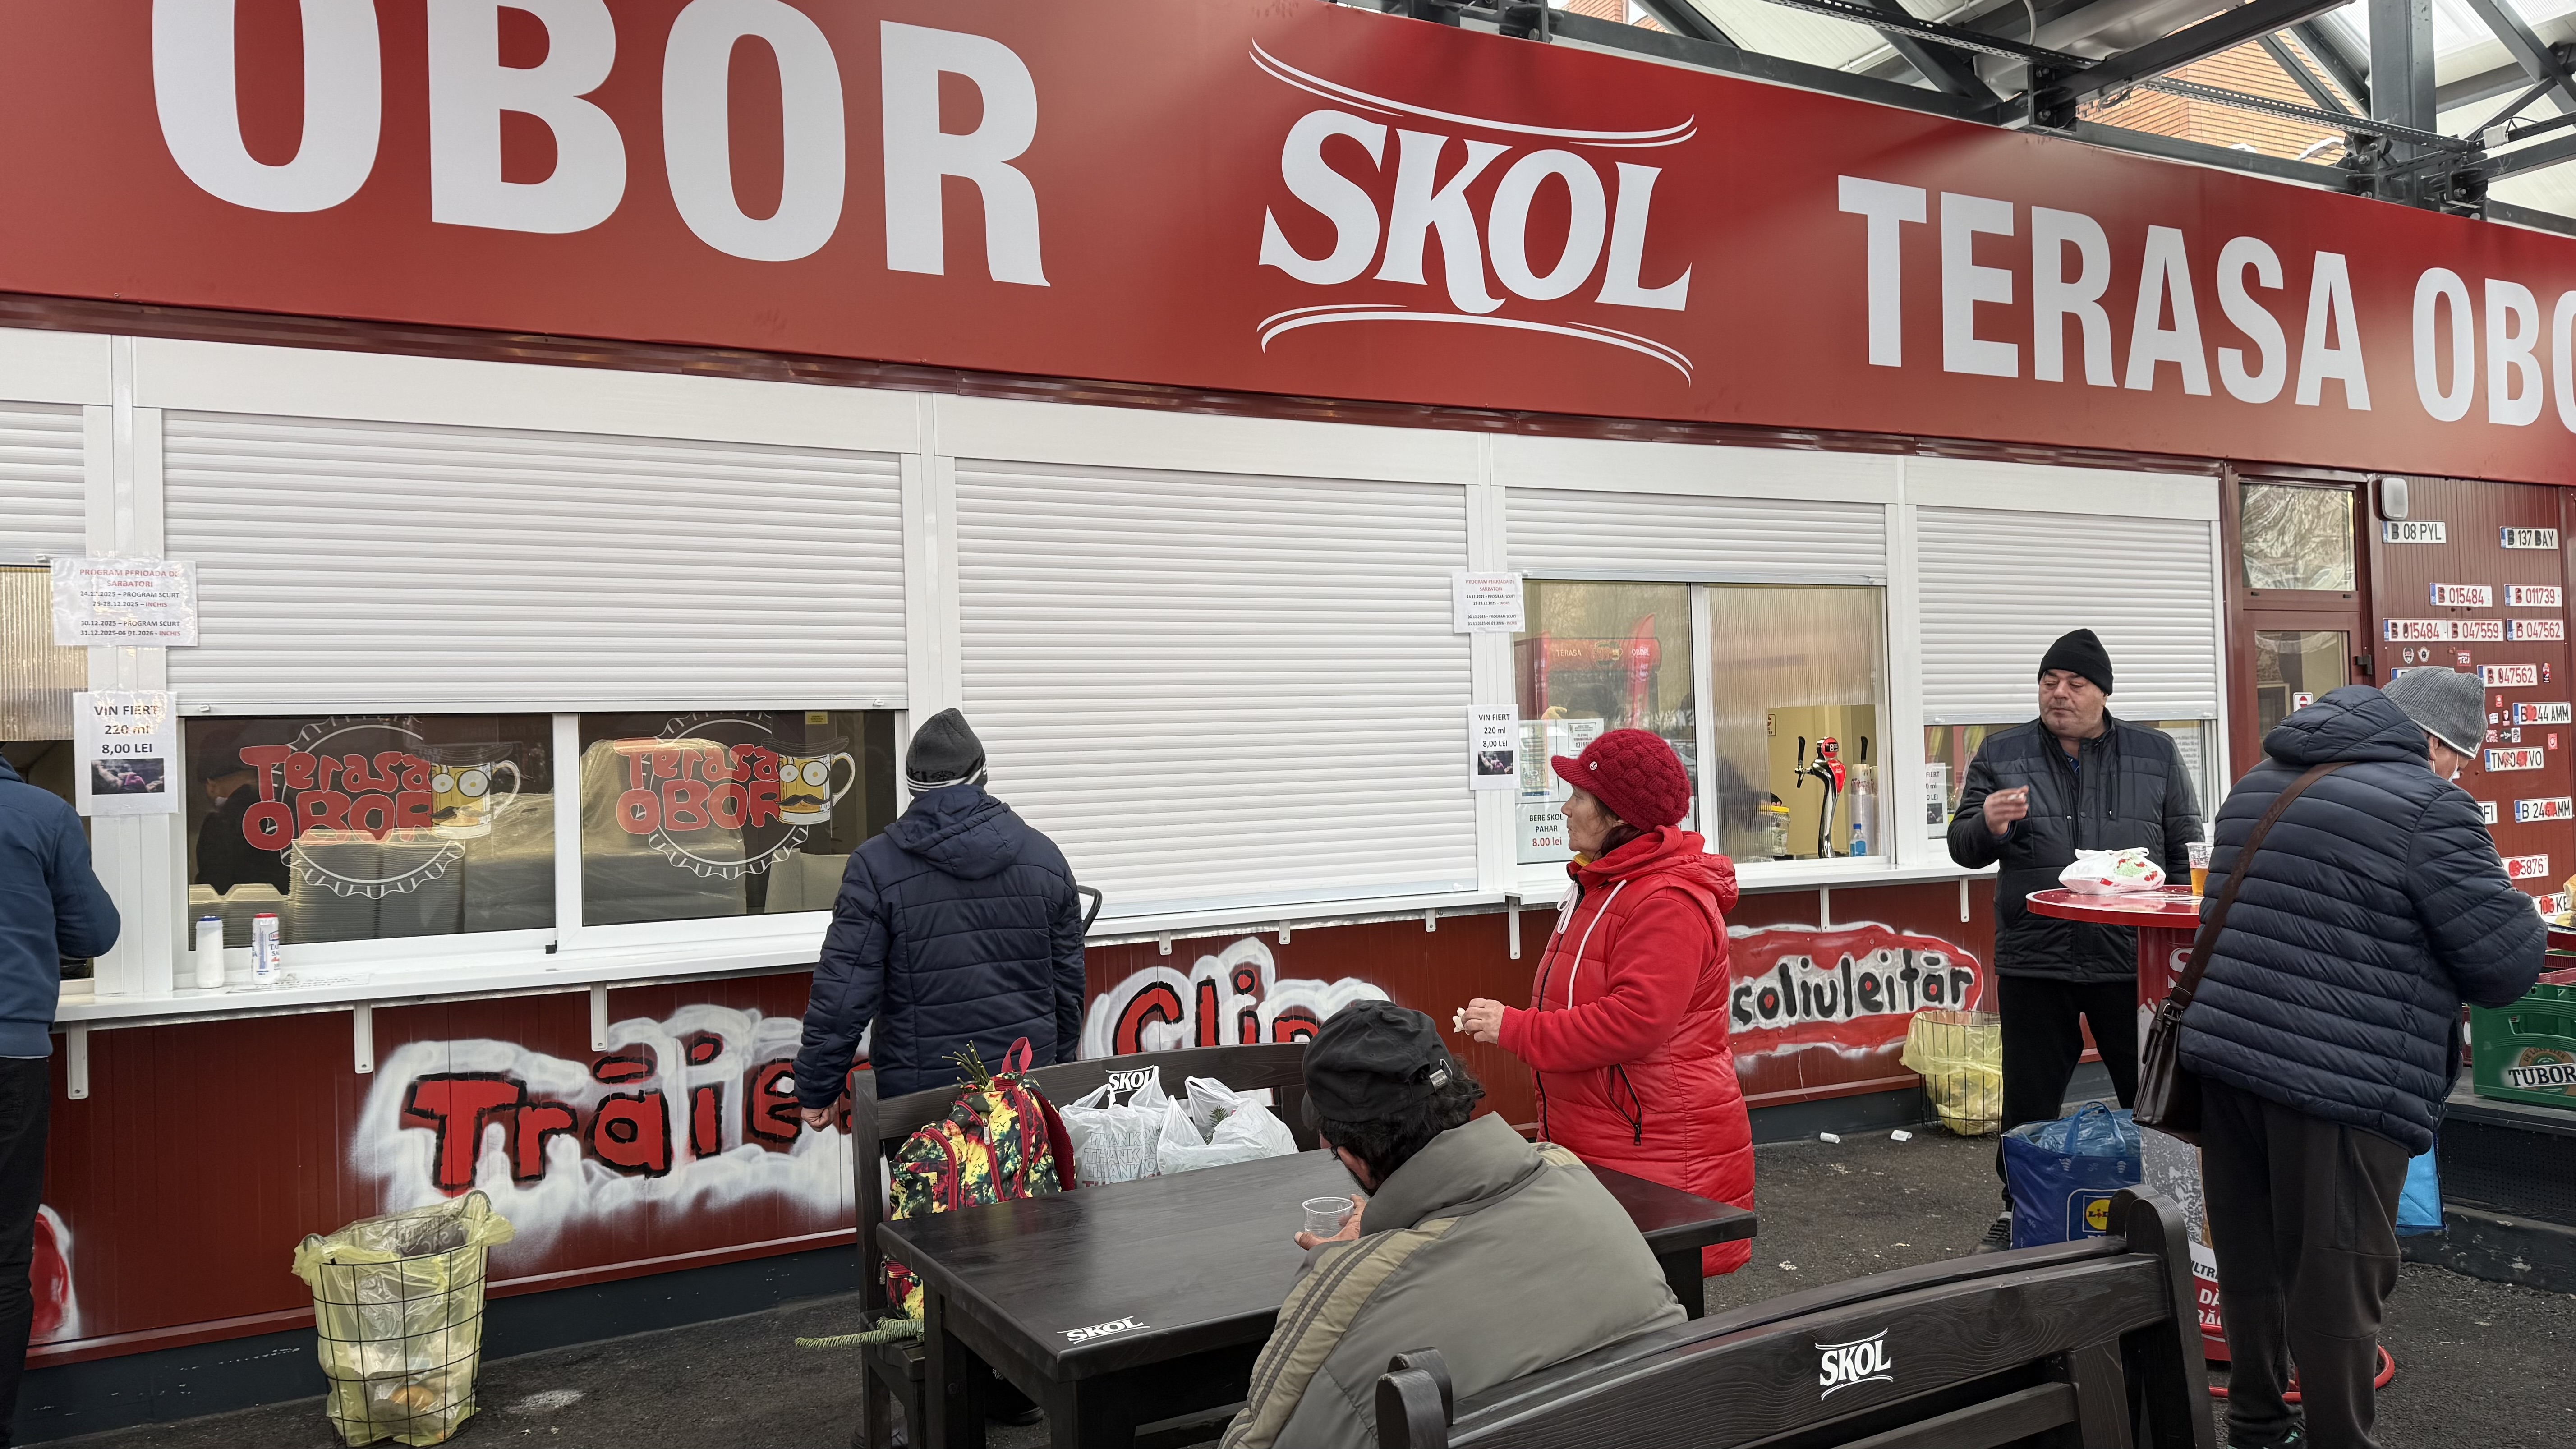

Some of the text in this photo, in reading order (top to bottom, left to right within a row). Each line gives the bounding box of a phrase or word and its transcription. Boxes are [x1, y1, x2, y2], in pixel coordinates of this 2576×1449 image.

[152, 0, 1050, 287] OBOR
[1259, 110, 1692, 314] SKOL
[1838, 175, 2372, 410] TERASA
[2391, 523, 2441, 540] B 08 PYL
[2507, 529, 2554, 547] B 137 BAY
[2438, 587, 2484, 604] B 015484
[2515, 588, 2555, 604] B 011739
[2391, 622, 2439, 639] B 015484
[2452, 622, 2499, 639] B 047559
[2516, 622, 2560, 638] B 047562
[2487, 667, 2533, 684] B 047562
[94, 705, 158, 715] VIN FIERT
[2551, 704, 2569, 722] AMM
[105, 725, 129, 734] 220
[102, 743, 152, 755] 8,00 LEI
[613, 737, 780, 790] Terasa
[239, 745, 432, 802] Terasa
[616, 779, 781, 835] OBOR
[2522, 803, 2529, 819] B
[242, 790, 433, 851] OBOR
[1532, 837, 1562, 846] 8.00 lei
[1090, 1132, 1141, 1147] THANK
[1084, 1148, 1141, 1164] THANK
[1067, 1319, 1144, 1341] SKOL
[1820, 1340, 1891, 1386] SKOL
